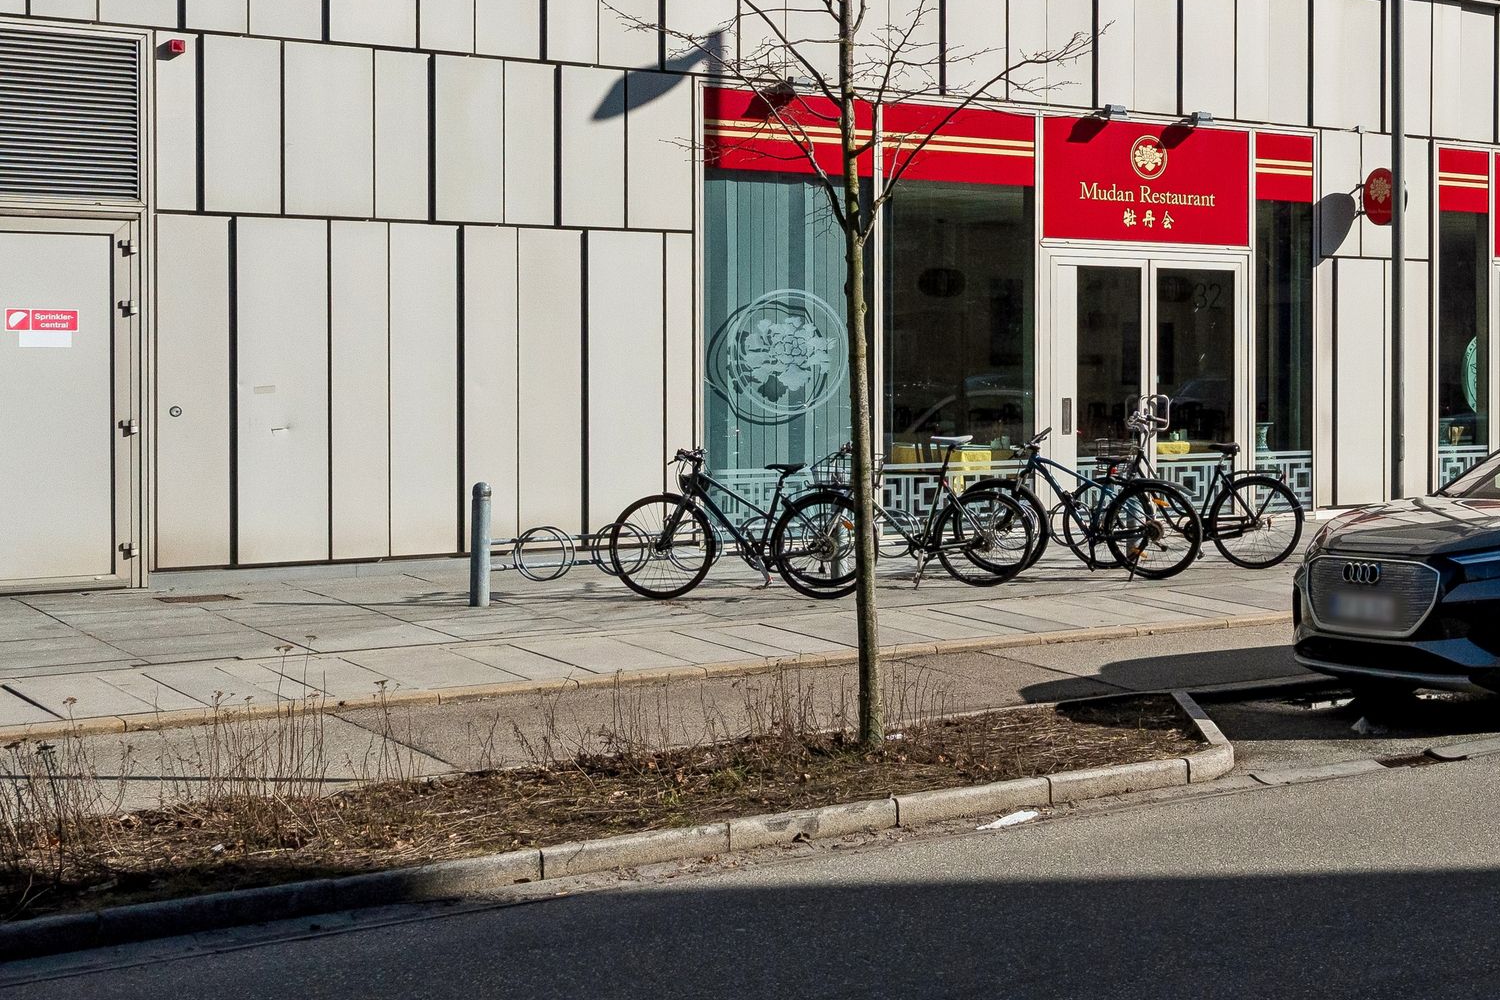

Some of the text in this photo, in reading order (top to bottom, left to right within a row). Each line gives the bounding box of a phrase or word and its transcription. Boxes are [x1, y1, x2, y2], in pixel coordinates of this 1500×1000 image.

[1080, 181, 1216, 207] Mudan Restaurant
[1194, 282, 1222, 309] 32
[34, 313, 75, 321] Sprinkler-
